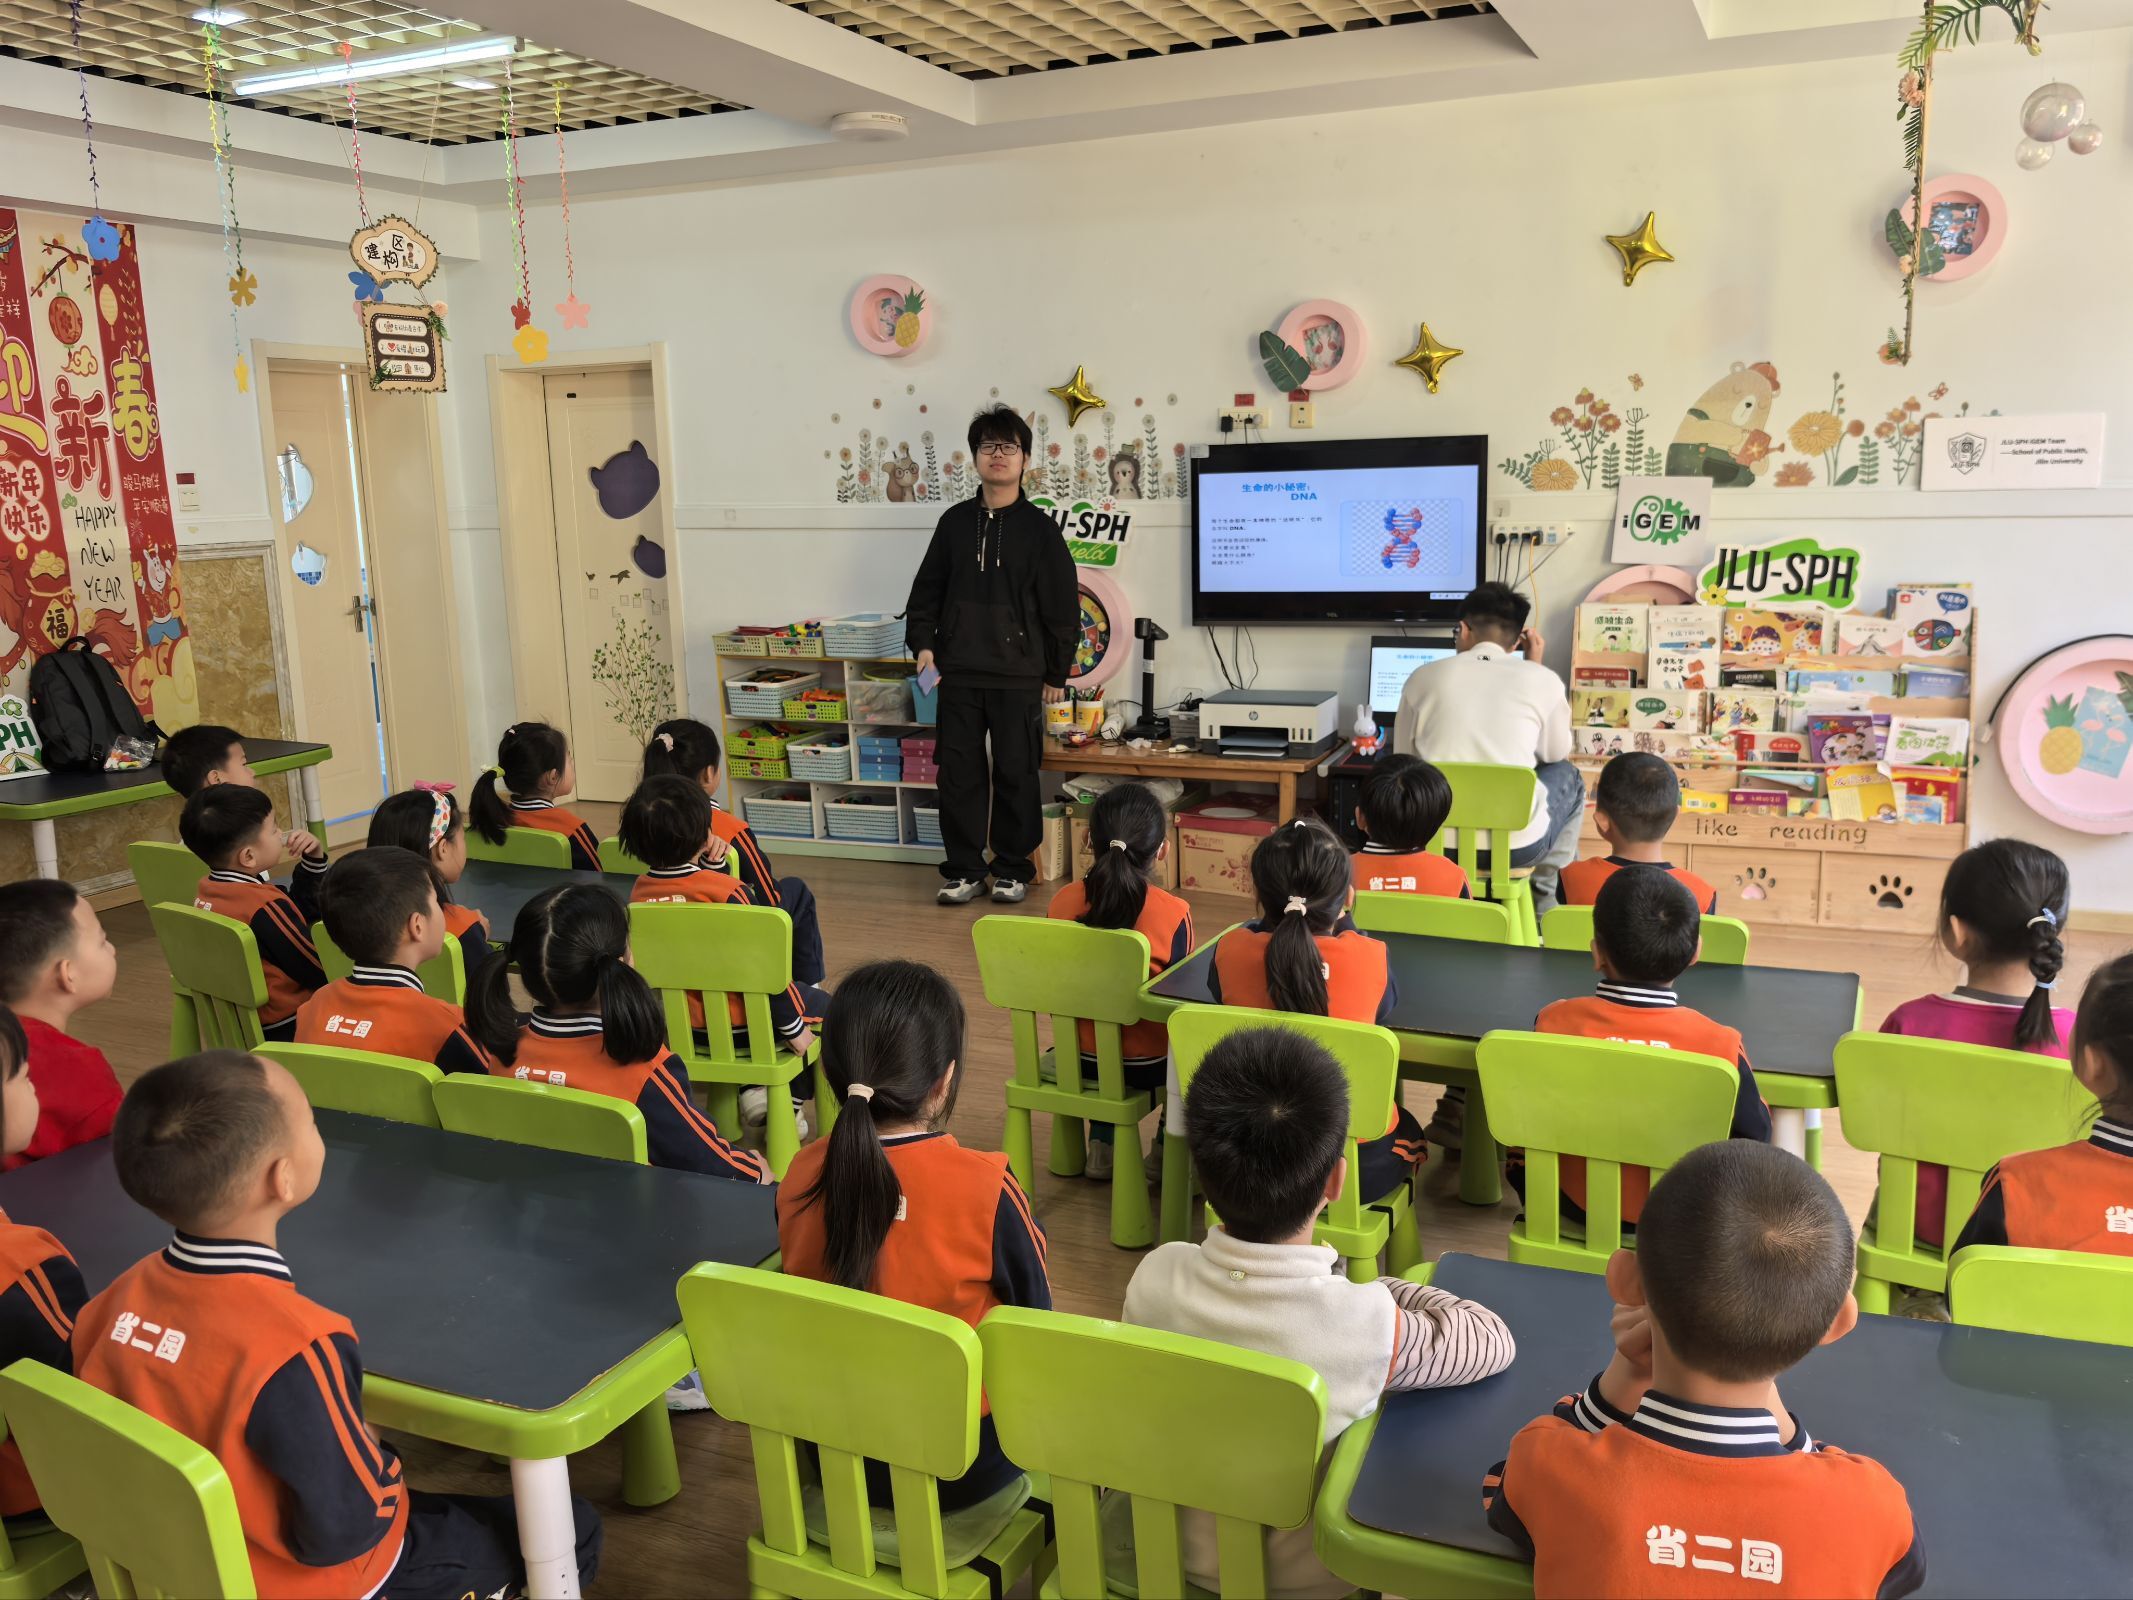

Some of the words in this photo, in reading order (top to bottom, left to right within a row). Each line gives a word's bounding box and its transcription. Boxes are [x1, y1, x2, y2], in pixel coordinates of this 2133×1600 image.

[1290, 492, 1318, 501] DNA
[4, 503, 47, 536] 快乐
[75, 502, 117, 532] HAPPY
[1622, 513, 1701, 532] iGEM
[81, 537, 115, 567] NEW
[83, 576, 125, 602] YEAR
[46, 610, 69, 641] 福
[1696, 818, 1738, 837] like
[1769, 823, 1867, 844] reading
[1369, 876, 1417, 891] 省二园
[325, 1014, 373, 1039] 省二园
[110, 1311, 186, 1364] 省二园
[1645, 1524, 1783, 1585] 省二园
